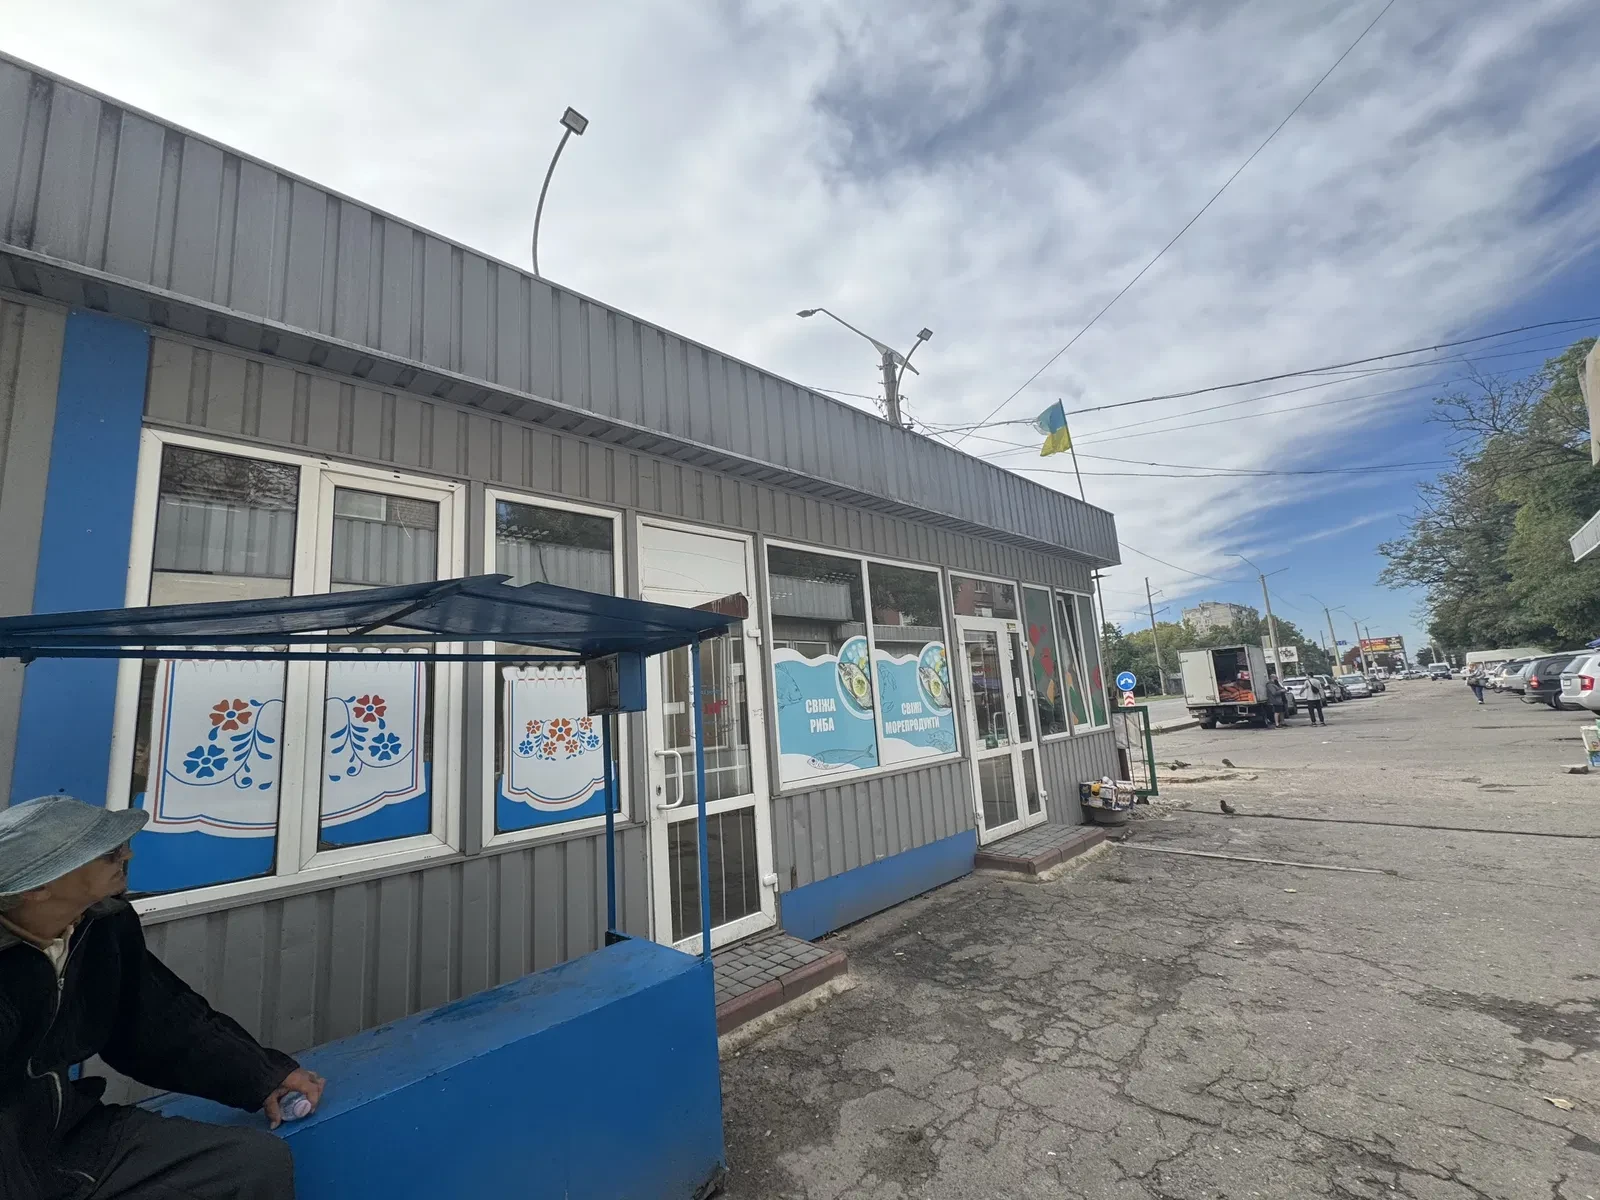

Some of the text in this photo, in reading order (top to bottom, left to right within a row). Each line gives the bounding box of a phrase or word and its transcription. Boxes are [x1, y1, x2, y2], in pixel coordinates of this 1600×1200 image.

[805, 698, 836, 714] СВІЖА
[901, 702, 922, 715] СВІЖІ
[809, 717, 835, 733] РИБА
[885, 717, 940, 734] МОРЕПРОДУКТИ
